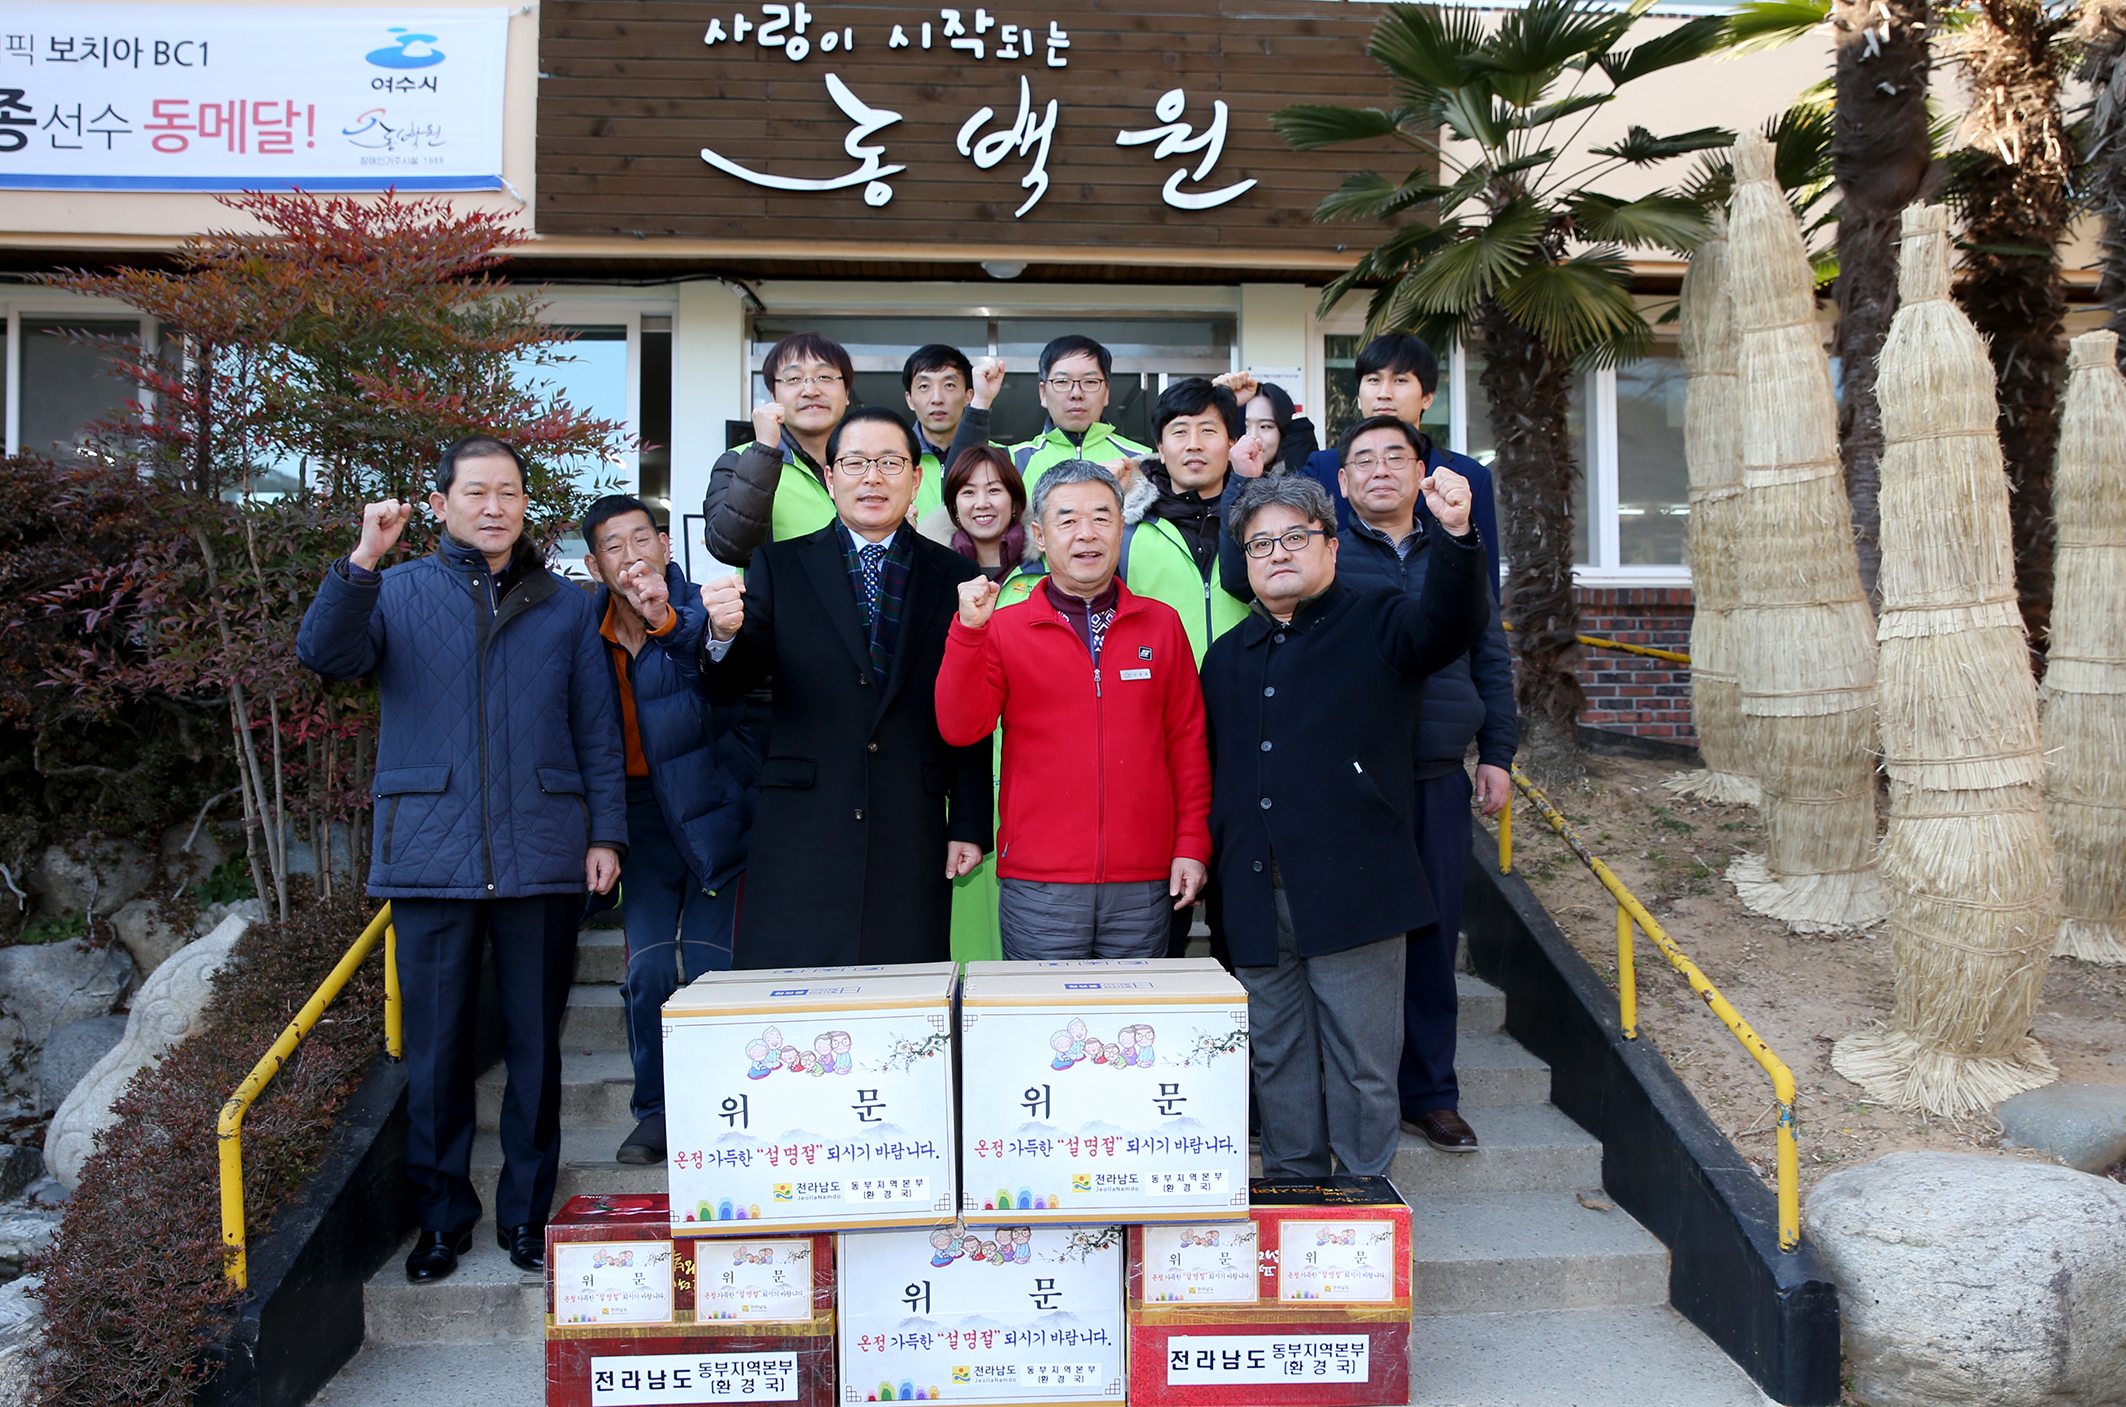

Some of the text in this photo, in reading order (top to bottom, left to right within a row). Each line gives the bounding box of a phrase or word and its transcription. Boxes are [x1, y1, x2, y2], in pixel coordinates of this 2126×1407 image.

[704, 2, 1071, 67] 사랑이 시작되는
[5, 34, 210, 69] 픽 보치아 BC1
[371, 76, 437, 93] 여수시
[143, 99, 316, 154] 동메달!
[718, 1089, 887, 1129] 위 문
[1020, 1083, 1187, 1120] 위 문
[673, 1151, 703, 1170] 온정
[708, 1149, 753, 1168] 가득한
[826, 1143, 871, 1163] 되시기
[974, 1139, 1004, 1159] 온정
[1008, 1137, 1053, 1157] 가득한
[1126, 1137, 1170, 1155] 되시기
[796, 1181, 841, 1194] 전라남도
[1095, 1173, 1139, 1185] 전라남도
[902, 1278, 1062, 1315] 위 문
[857, 1334, 886, 1352] 온정
[890, 1333, 934, 1351] 가득한
[1004, 1329, 1046, 1347] 되시기
[1272, 1343, 1365, 1359] 동부지역본부
[699, 1360, 793, 1379] 동부지역본부
[974, 1365, 1017, 1376] 전라남도
[1170, 1350, 1266, 1371] 전라남도
[595, 1369, 692, 1392] 전라남도
